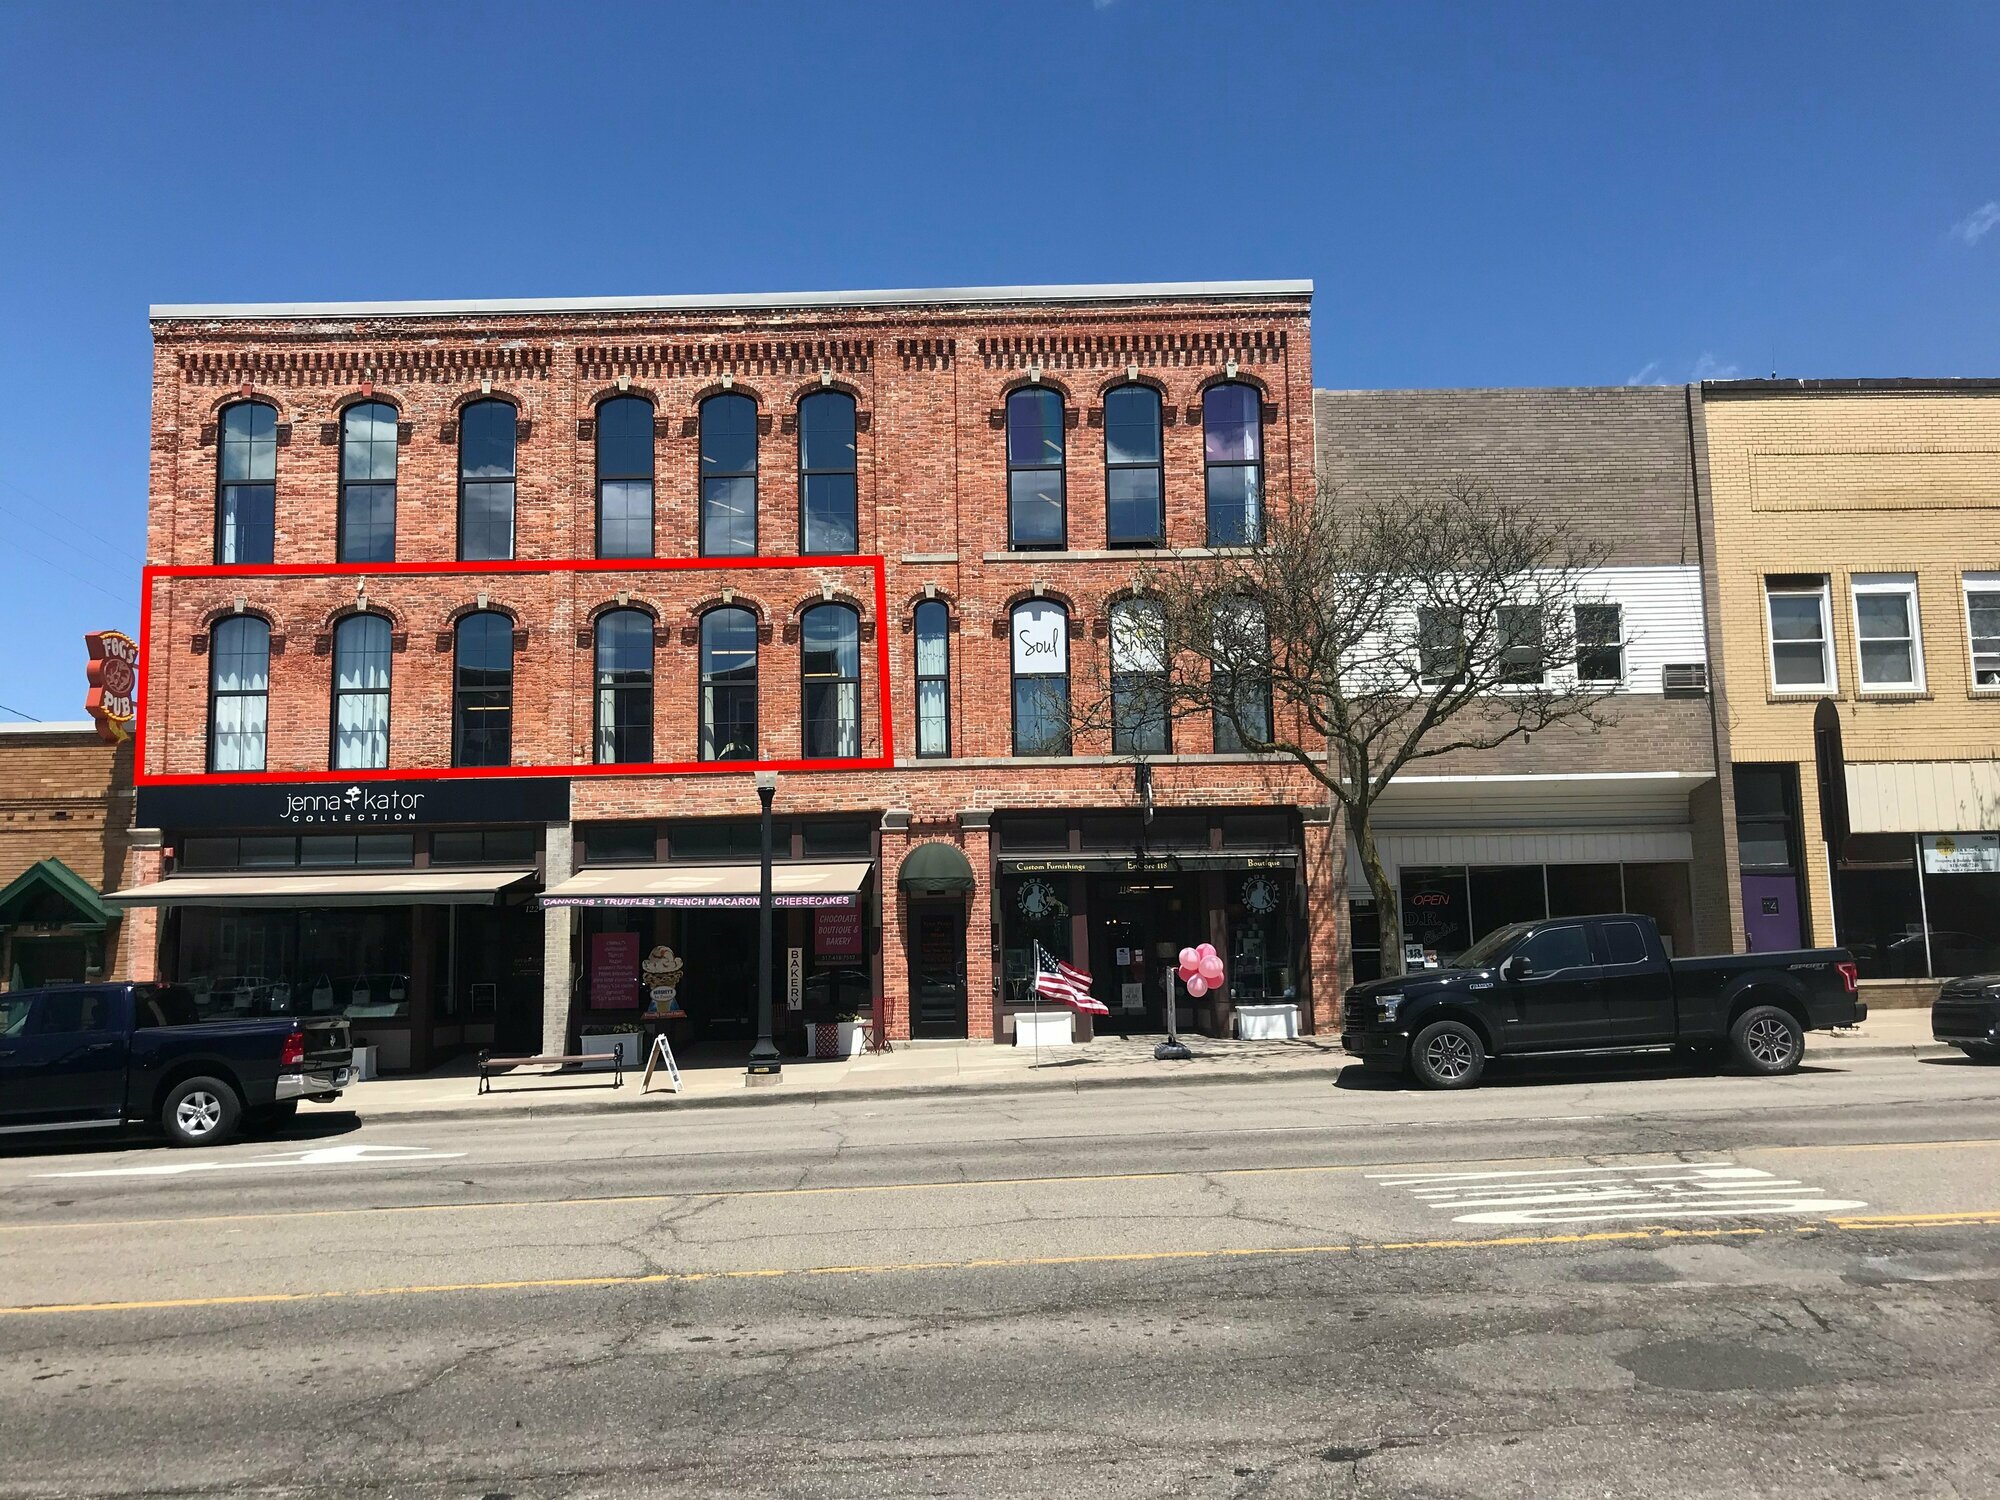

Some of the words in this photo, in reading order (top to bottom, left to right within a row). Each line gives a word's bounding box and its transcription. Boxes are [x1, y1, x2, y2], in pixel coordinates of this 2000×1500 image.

[1019, 627, 1059, 659] Soul
[102, 637, 136, 665] FOG'S
[104, 690, 131, 717] PUB
[280, 793, 341, 818] jenna
[364, 788, 425, 810] kator
[292, 813, 417, 823] COLLECTION
[1016, 862, 1045, 871] Custom
[1046, 861, 1086, 872] Furnishings
[1247, 859, 1280, 868] Boutique
[1017, 877, 1042, 895] MADE
[1045, 883, 1055, 894] IN
[1241, 874, 1266, 891] MADE
[1270, 880, 1280, 891] IN
[543, 898, 595, 906] CANNOLIS
[604, 897, 656, 906] TRUFFLES
[663, 898, 706, 906] FRENCH
[708, 897, 761, 906] MACARON
[774, 896, 850, 906] CHEESECAKES
[1413, 894, 1451, 906] OPEN
[526, 905, 539, 913] 122
[1241, 898, 1280, 915] DETROIT
[819, 914, 858, 924] CHOCOLATE
[818, 925, 852, 935] BOUTIQUE
[826, 936, 852, 946] BAKERY
[790, 950, 800, 1007] BAKERY
